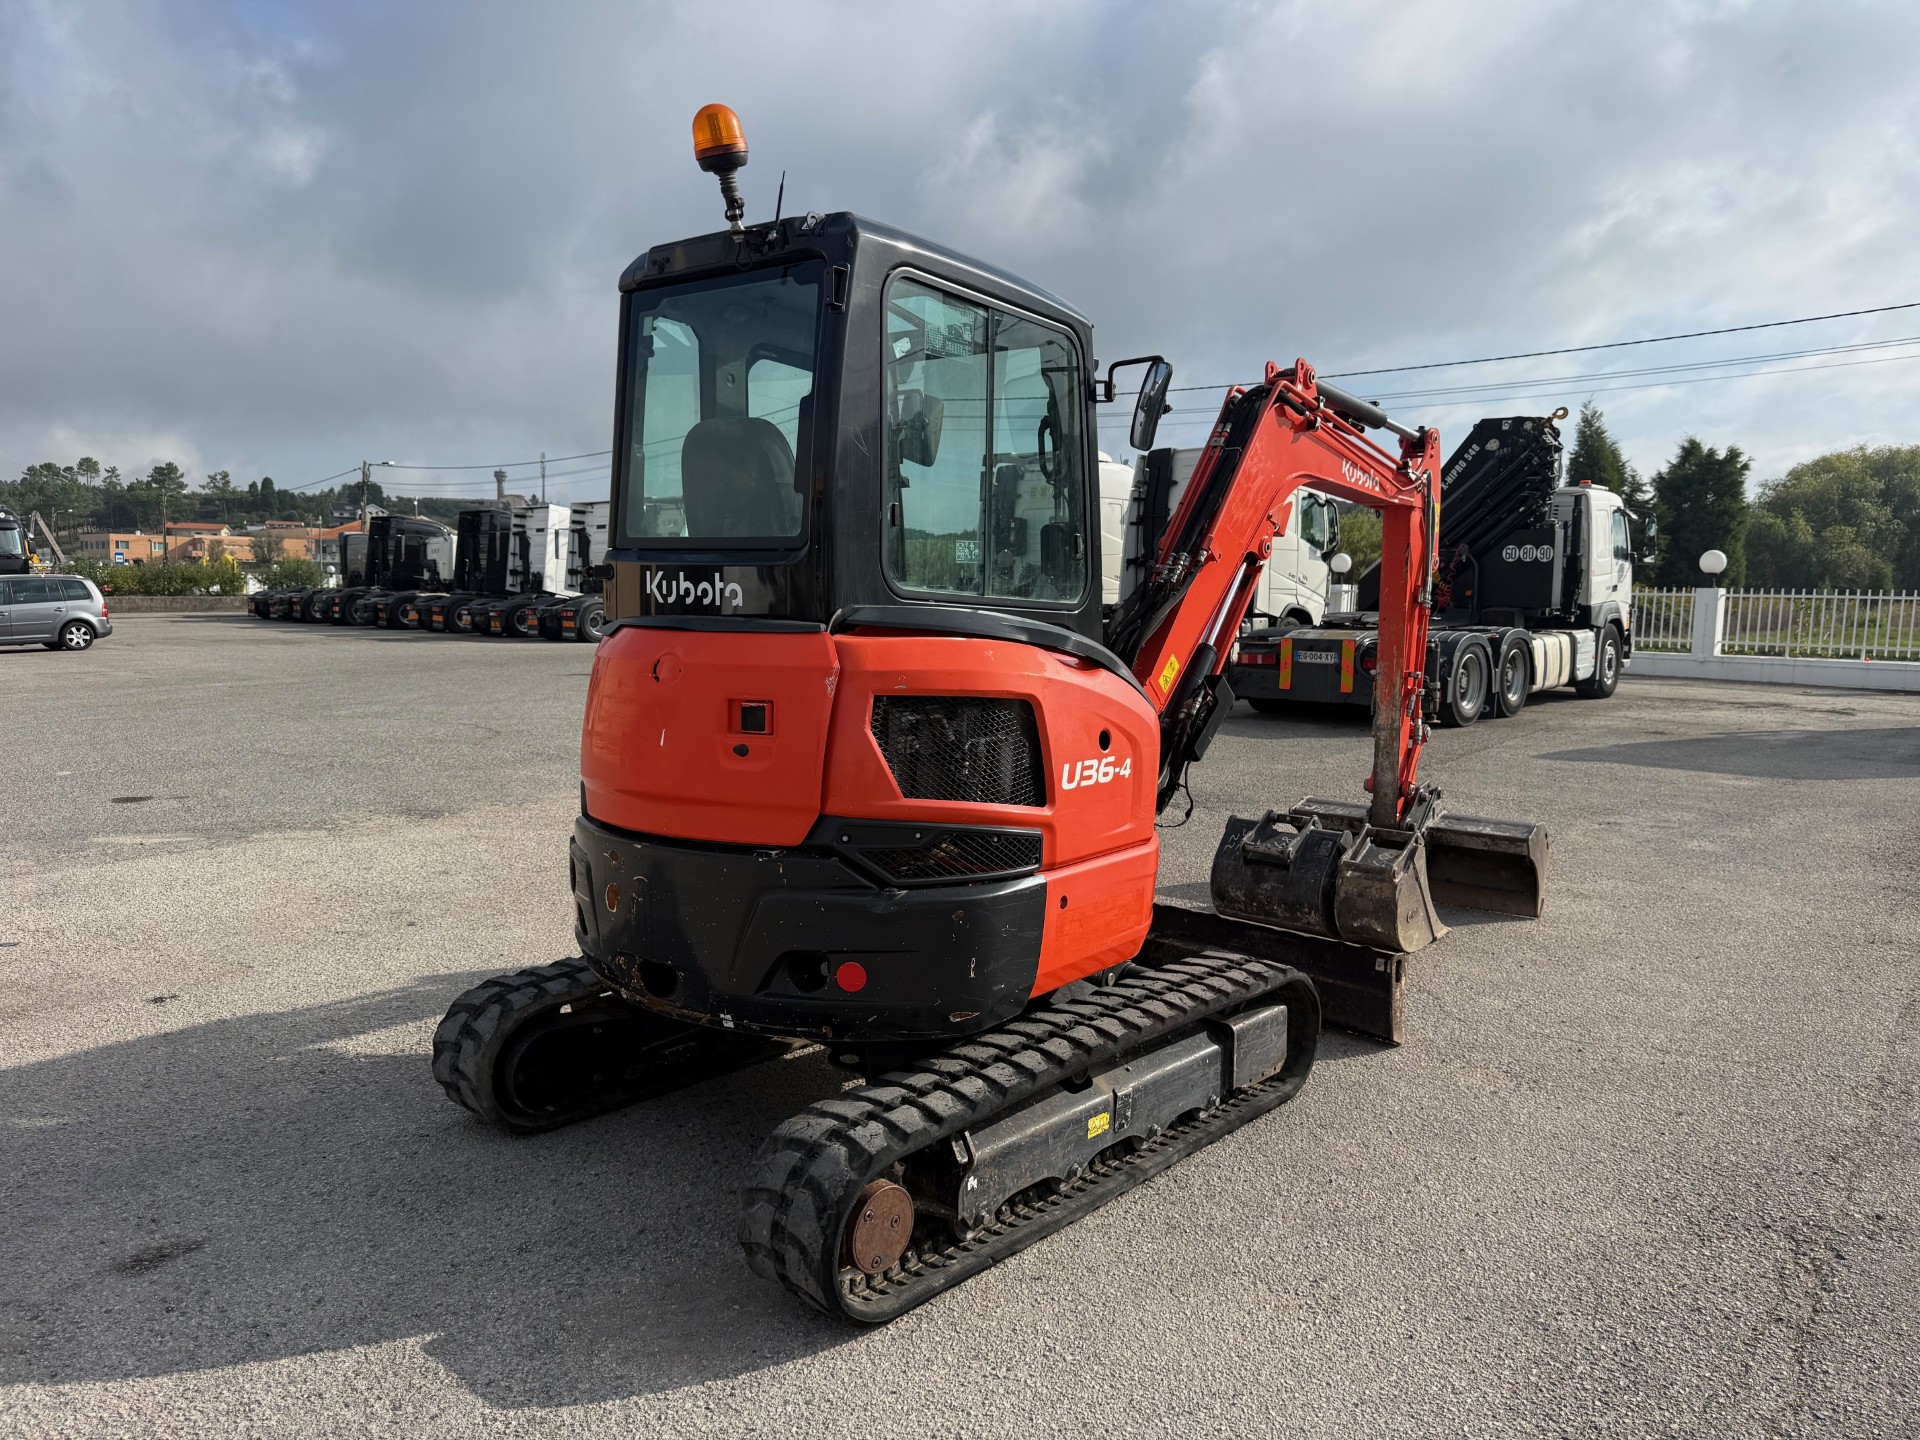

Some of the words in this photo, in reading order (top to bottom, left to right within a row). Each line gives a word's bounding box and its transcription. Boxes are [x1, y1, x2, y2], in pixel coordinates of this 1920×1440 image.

[1342, 458, 1380, 492] Kubota
[1440, 459, 1467, 491] X-HIPRO
[1464, 443, 1480, 461] 548
[1505, 547, 1517, 560] 60
[1522, 546, 1535, 560] 80
[1539, 547, 1552, 560] 90
[646, 570, 743, 607] Kubota
[1061, 755, 1131, 790] U36-4
